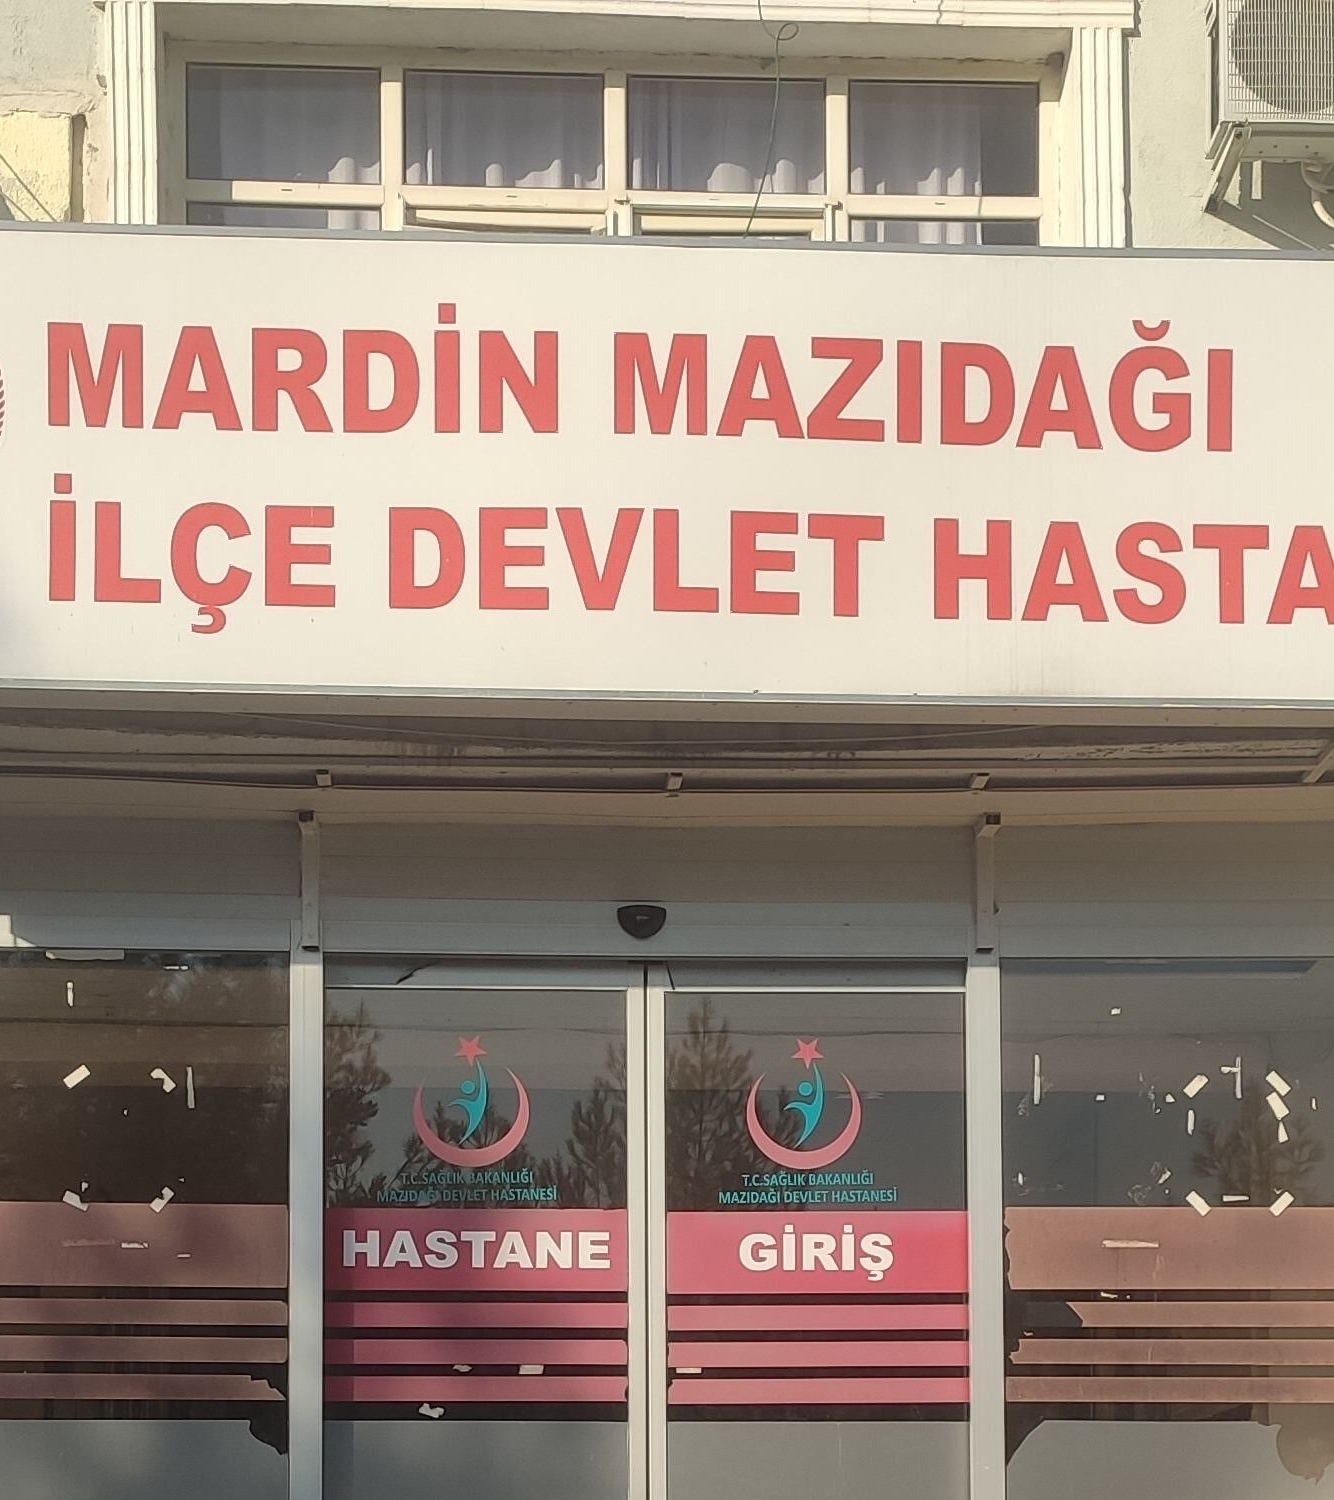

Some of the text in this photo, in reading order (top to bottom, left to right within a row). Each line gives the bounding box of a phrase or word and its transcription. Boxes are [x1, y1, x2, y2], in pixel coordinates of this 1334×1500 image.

[46, 303, 1235, 455] MARDİN MAZIDAĞI
[46, 473, 338, 635] İLÇE
[387, 506, 887, 620] DEVLET
[467, 1168, 533, 1185] BAKANLIĞI
[808, 1169, 874, 1186] BAKANLIĞI
[376, 1185, 557, 1203] MAZIDAĞI DEVLET HASTANESİ
[718, 1187, 897, 1204] MAZIDAĞI DEVLET HASTANESİ
[342, 1229, 612, 1270] HASTANE
[738, 1223, 895, 1281] GİRİŞ
